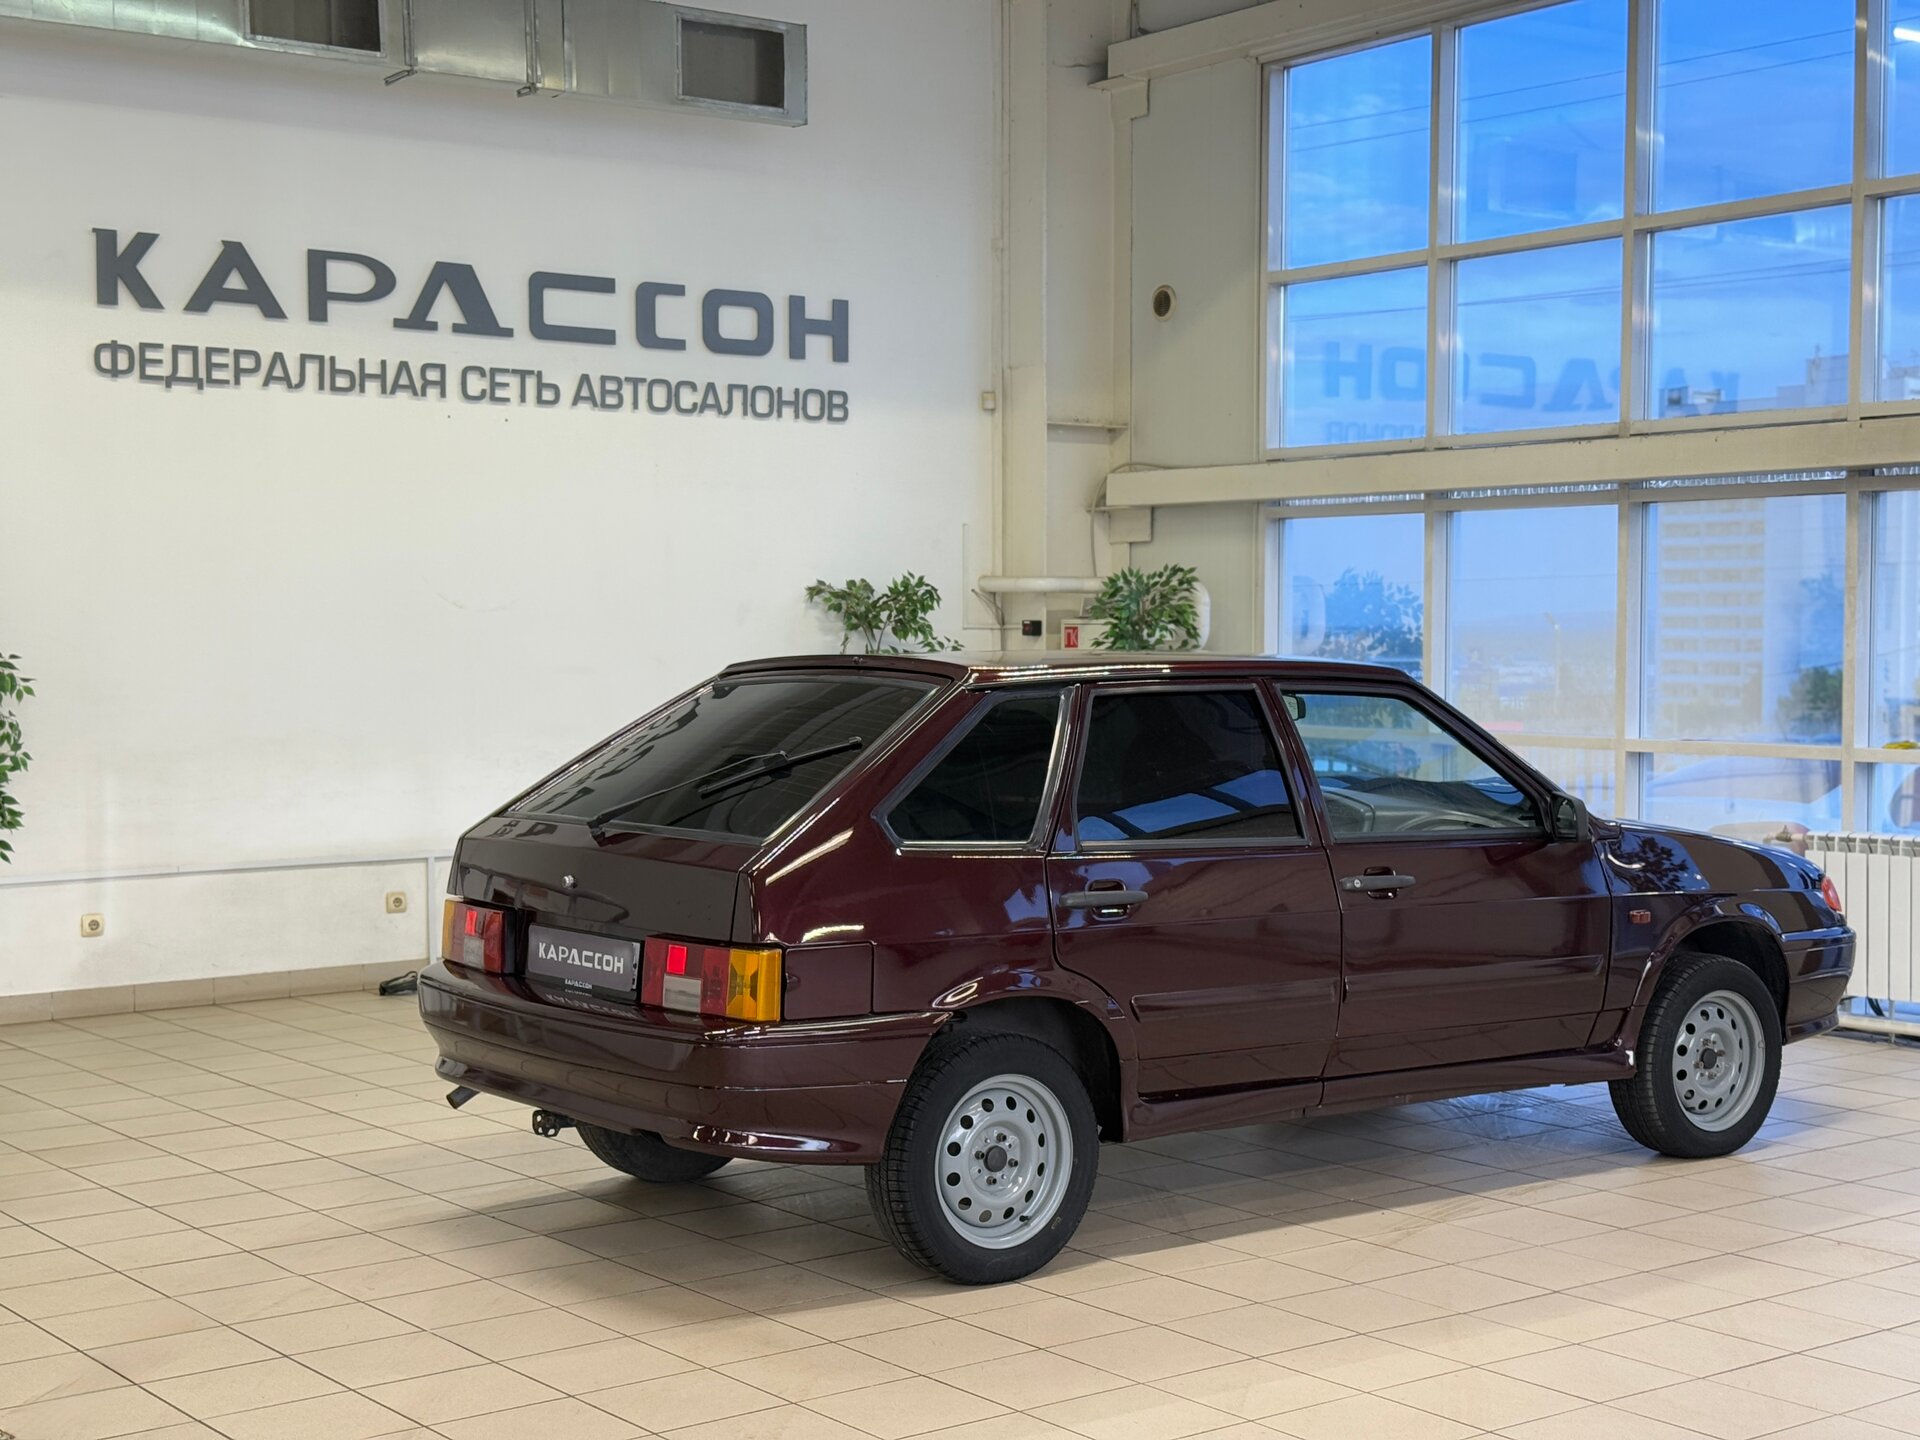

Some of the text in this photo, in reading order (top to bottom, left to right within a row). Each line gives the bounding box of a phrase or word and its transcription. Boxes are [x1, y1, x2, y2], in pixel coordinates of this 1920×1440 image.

[93, 340, 849, 423] ФЕДЕРАЛЬНАЯ СЕТЬ АВТОСАЛОНОВ
